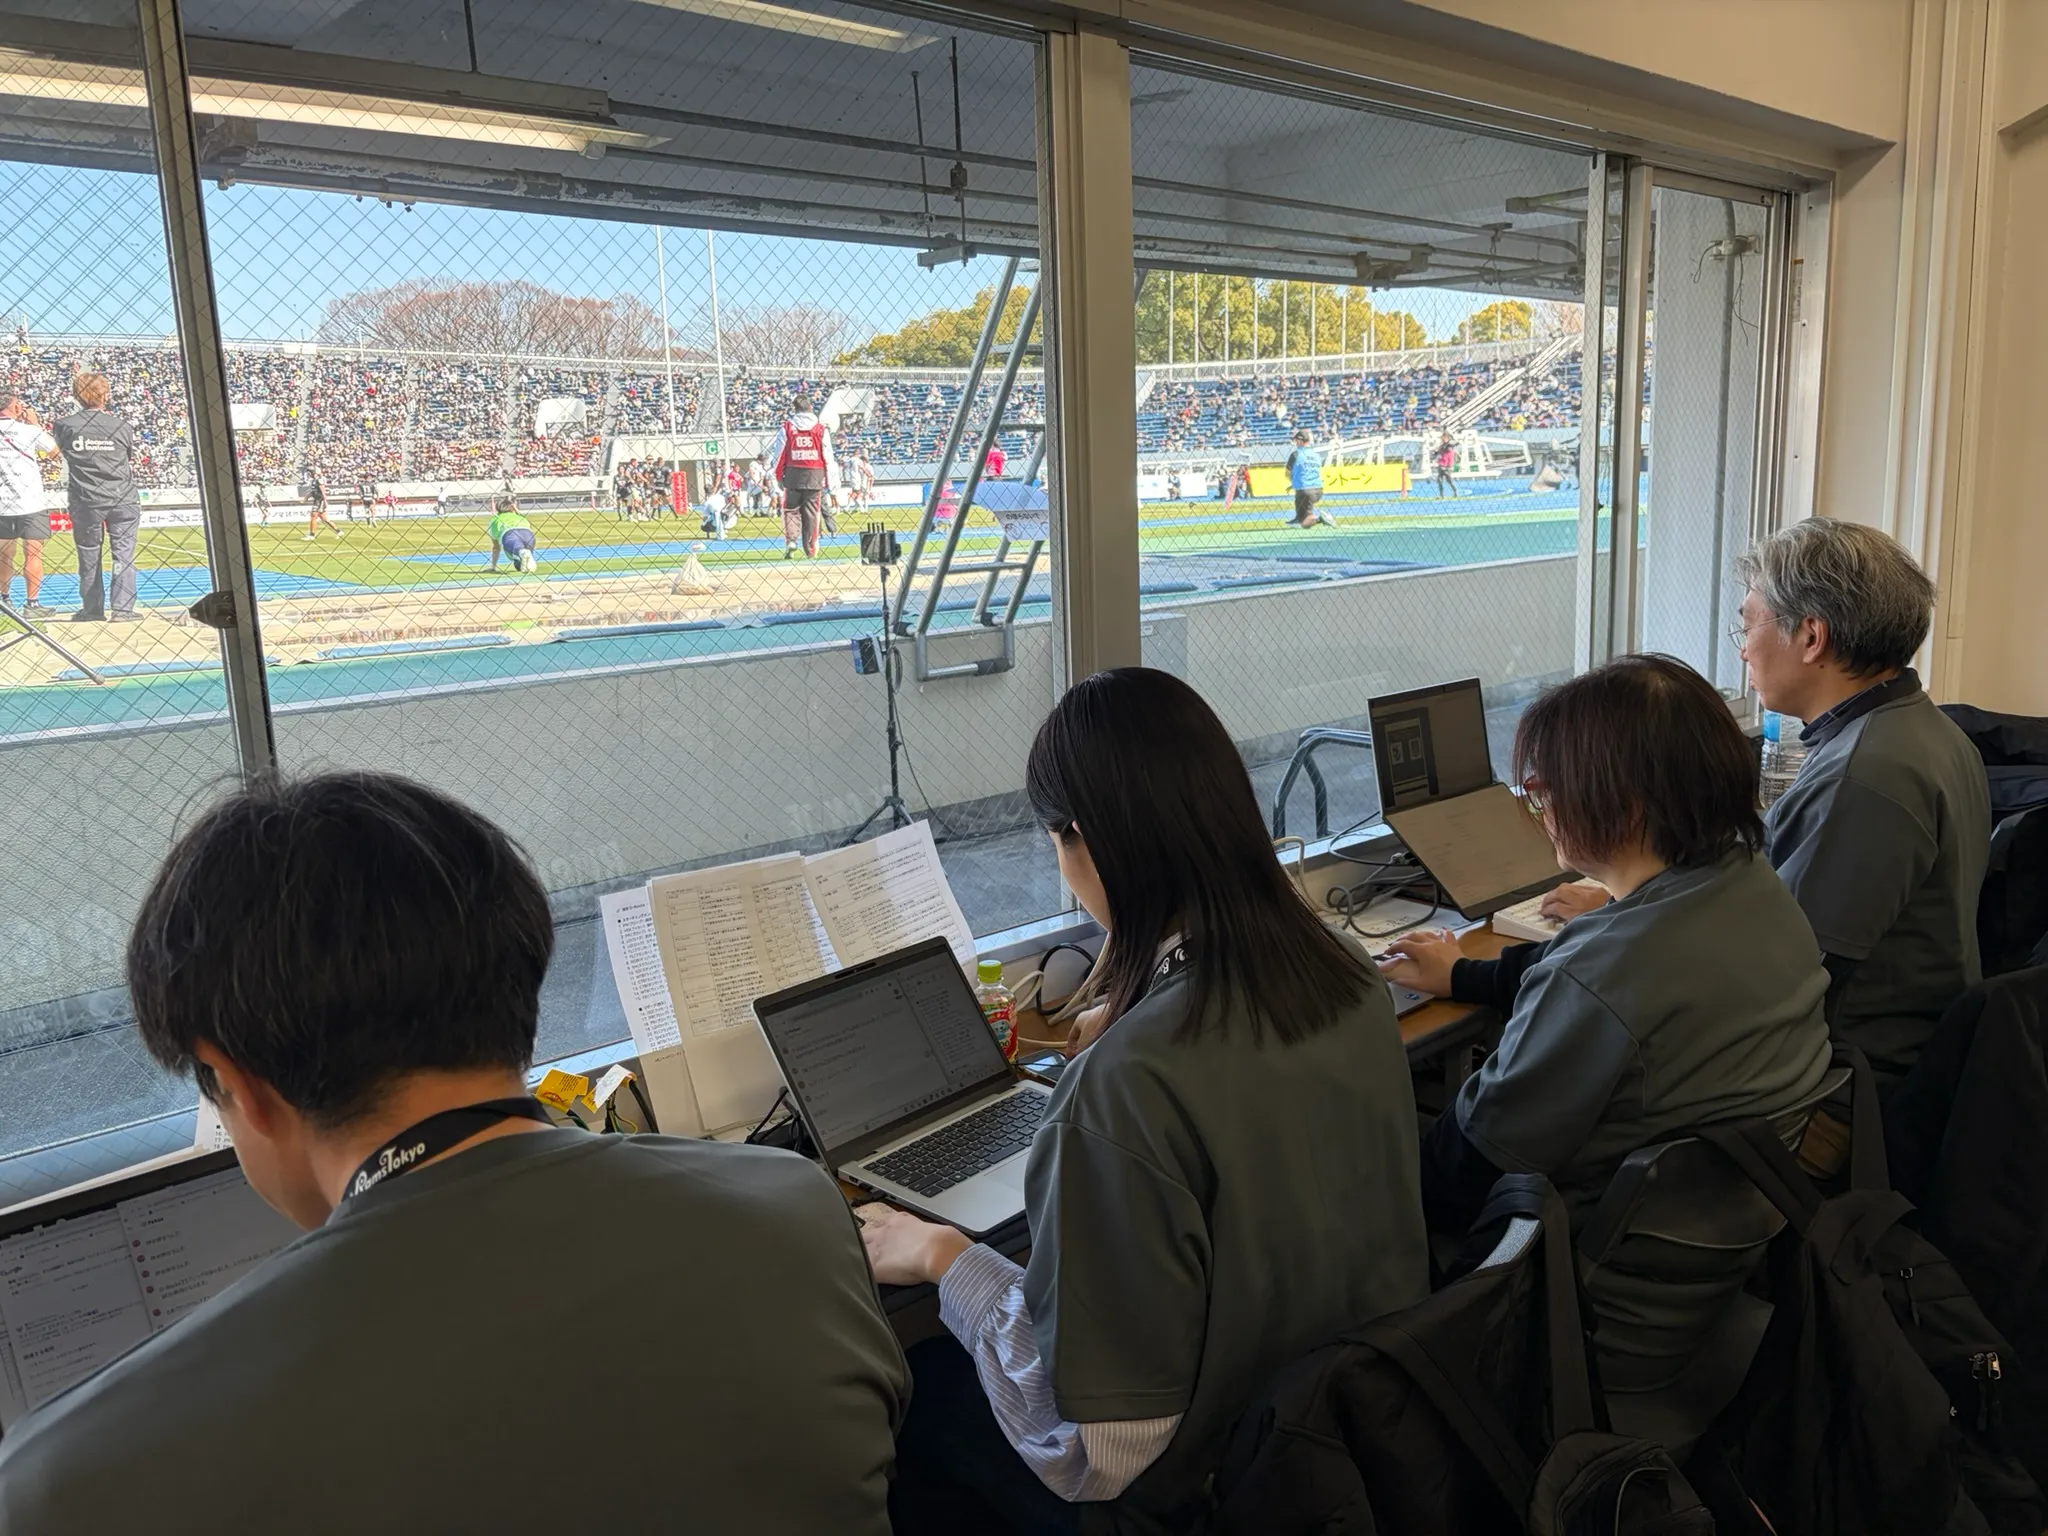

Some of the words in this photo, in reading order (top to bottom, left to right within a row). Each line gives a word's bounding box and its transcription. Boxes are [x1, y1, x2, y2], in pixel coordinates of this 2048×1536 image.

[1322, 472, 1374, 487] ントーン
[354, 1170, 389, 1196] Rams
[379, 1144, 426, 1174] Tokyo
